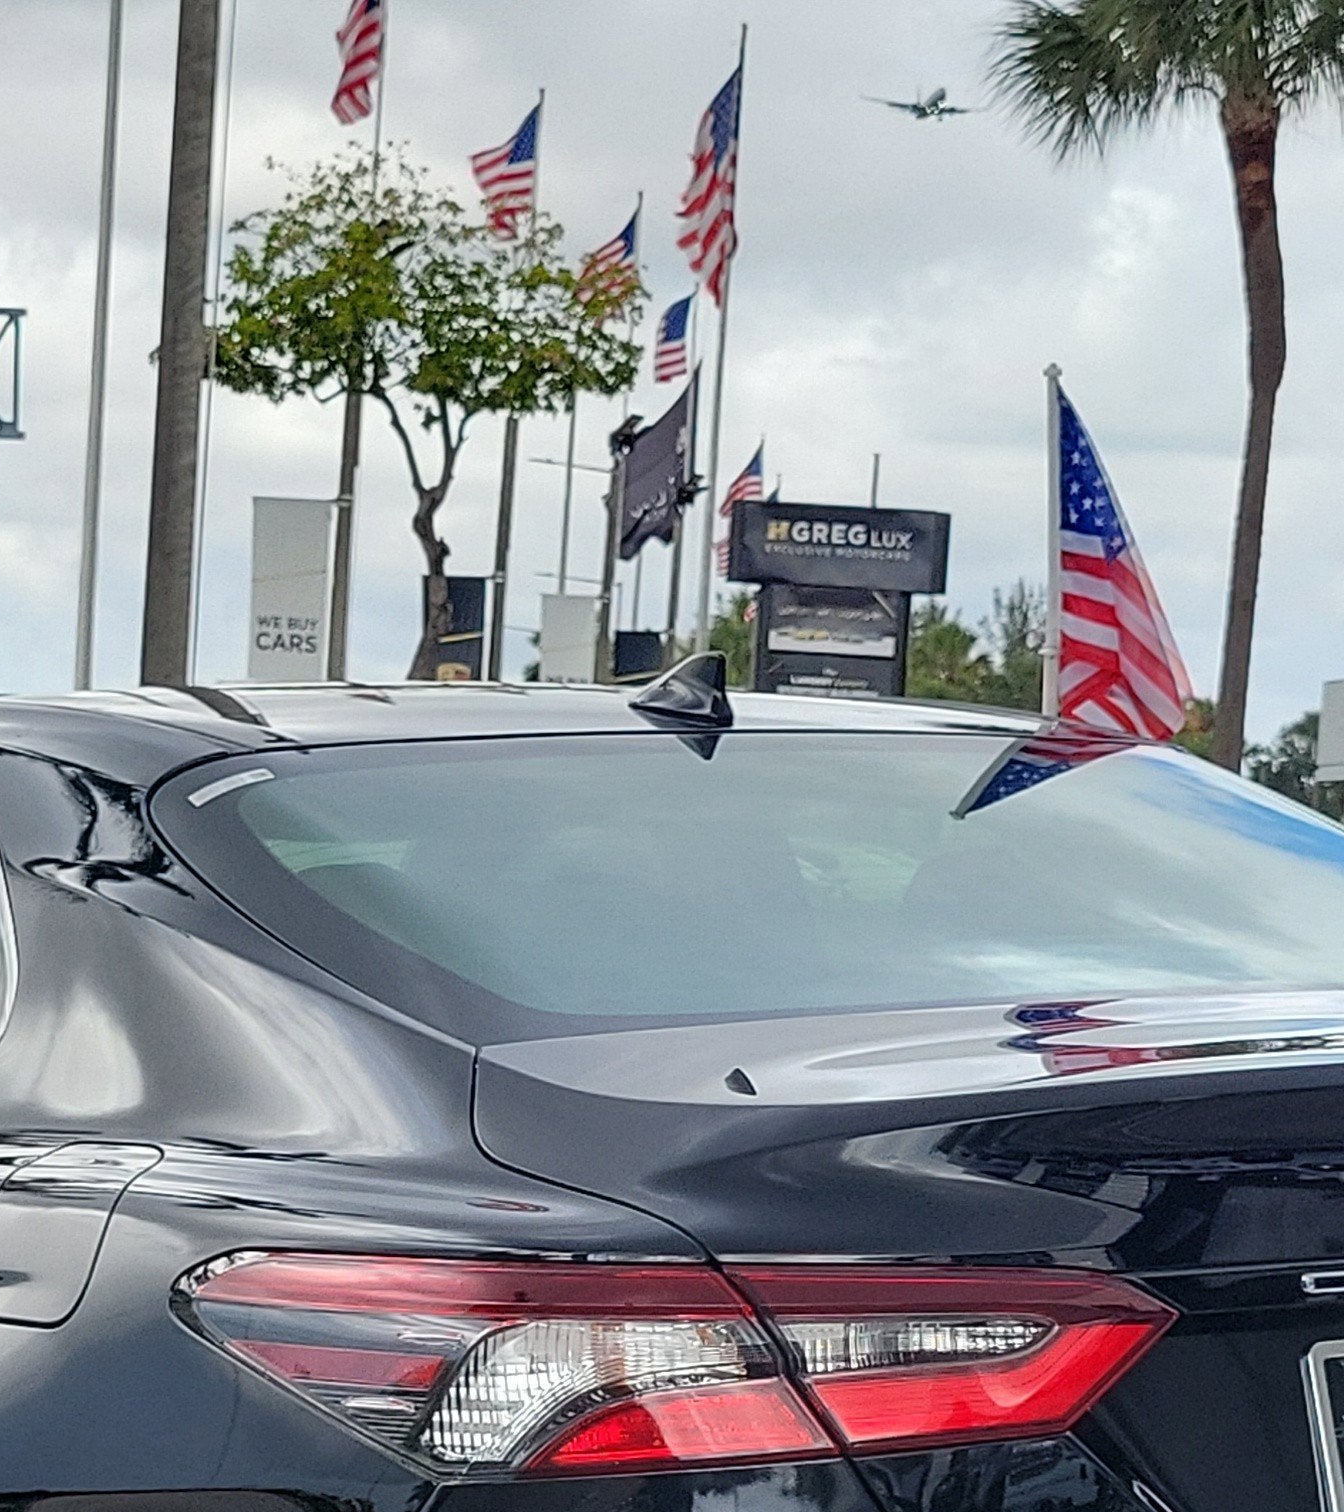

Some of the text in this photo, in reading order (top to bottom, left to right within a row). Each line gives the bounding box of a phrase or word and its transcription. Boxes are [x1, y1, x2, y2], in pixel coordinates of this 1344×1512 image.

[257, 615, 318, 630] WE BUY
[256, 632, 317, 653] CARS
